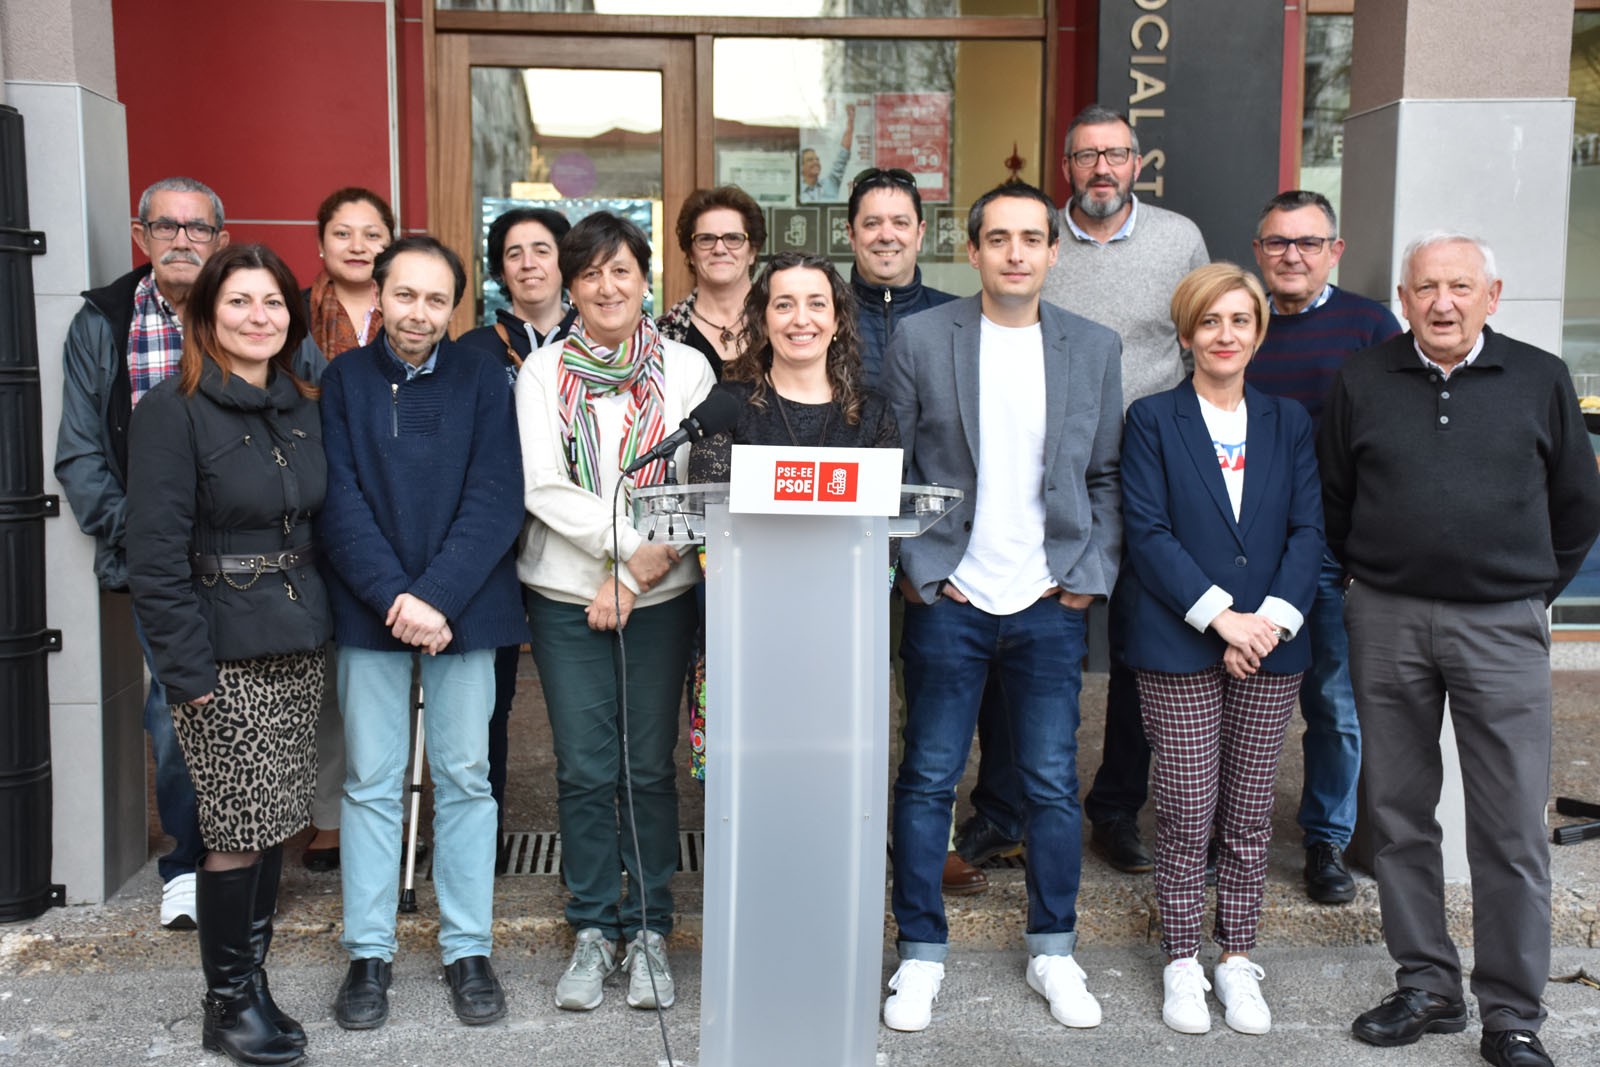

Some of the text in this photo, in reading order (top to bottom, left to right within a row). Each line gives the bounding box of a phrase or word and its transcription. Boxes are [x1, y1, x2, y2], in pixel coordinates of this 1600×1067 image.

[1129, 0, 1169, 127] CIAL
[777, 466, 813, 478] PSE-EE
[776, 478, 813, 494] PSOE
